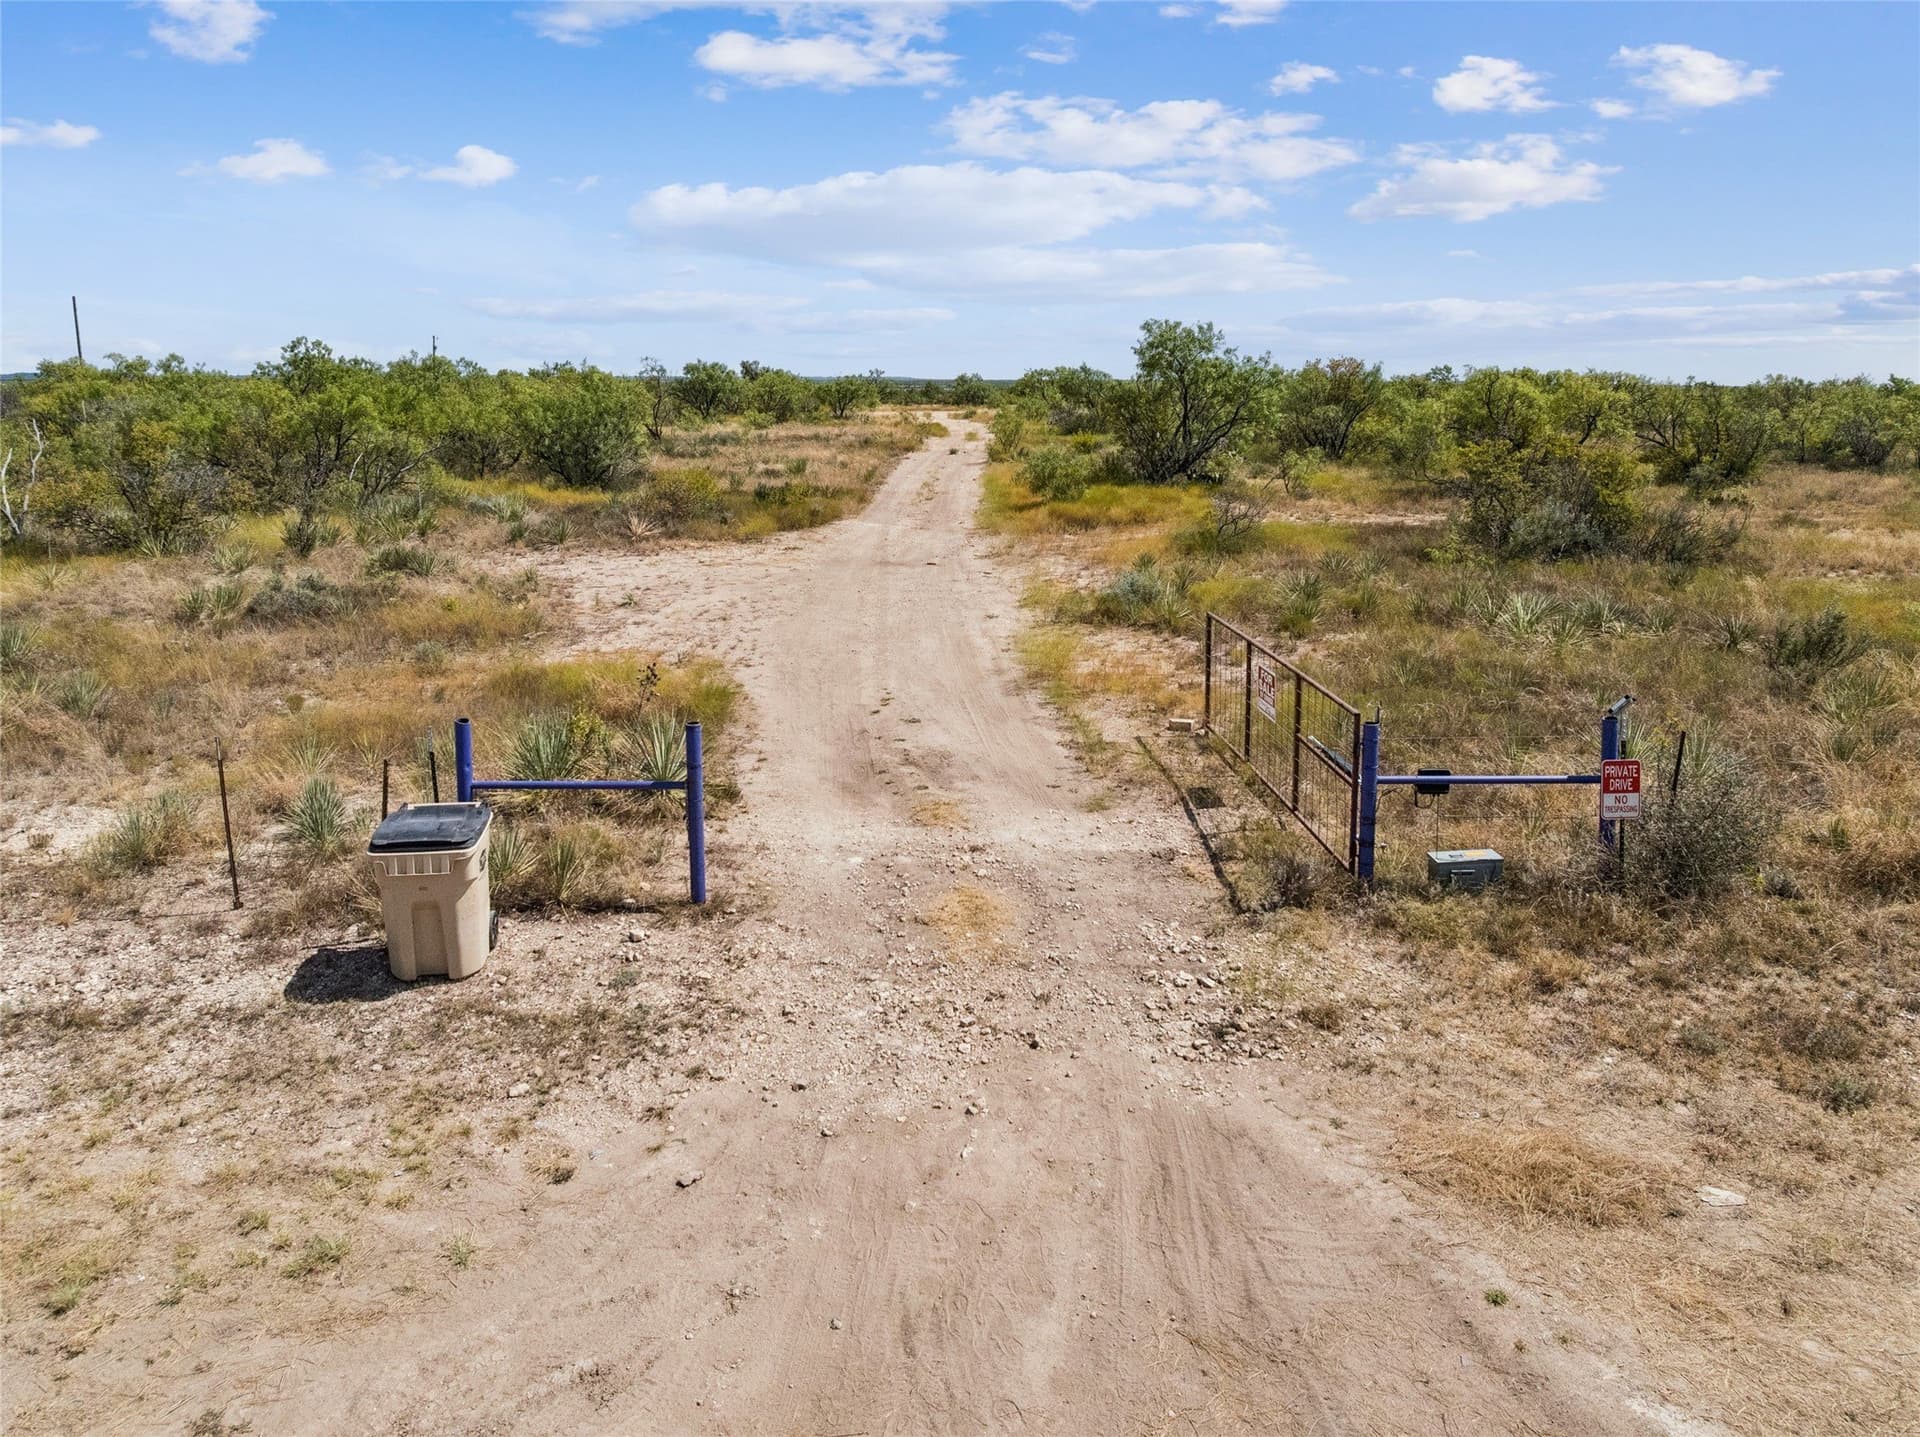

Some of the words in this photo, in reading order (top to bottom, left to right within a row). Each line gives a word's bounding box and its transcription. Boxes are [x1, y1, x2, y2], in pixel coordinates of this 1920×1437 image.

[1260, 669, 1273, 685] FOR
[1605, 765, 1638, 778] PRIVATE
[1609, 778, 1633, 791] DRIVE
[1614, 795, 1628, 804] NO
